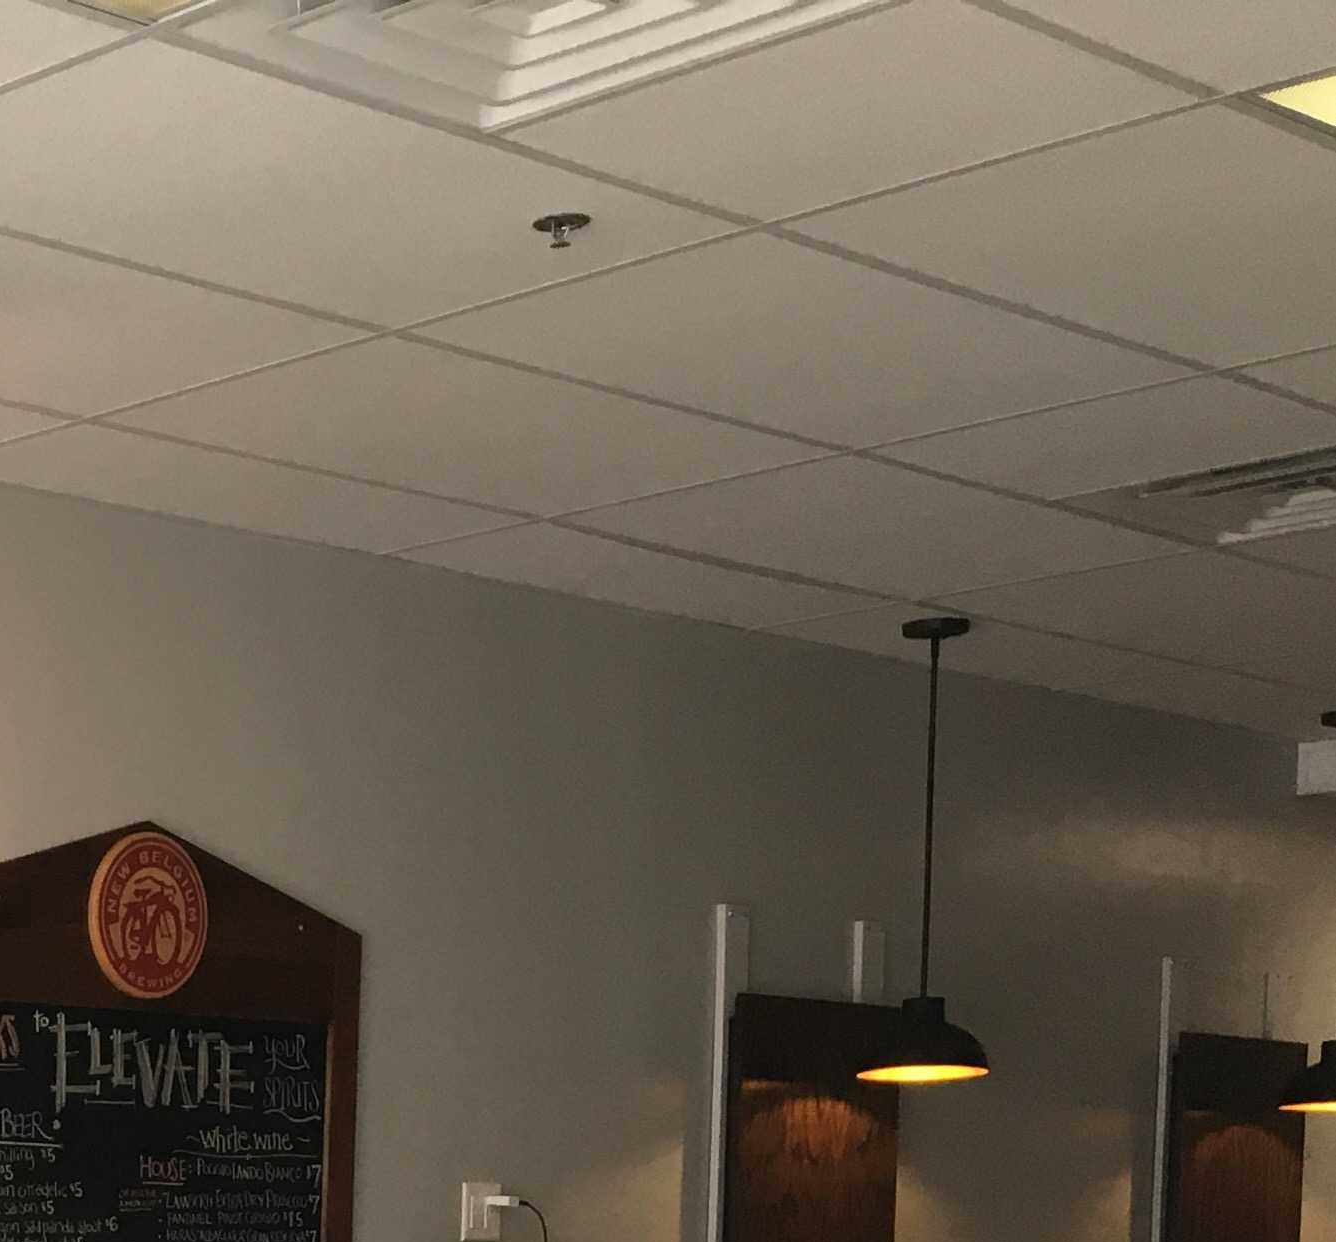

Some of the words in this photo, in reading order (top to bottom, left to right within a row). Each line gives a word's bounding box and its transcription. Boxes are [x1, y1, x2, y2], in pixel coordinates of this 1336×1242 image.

[107, 866, 131, 913] NEW
[138, 851, 198, 923] BELGIUM
[119, 963, 184, 988] BREWING
[33, 1010, 50, 1033] to
[49, 1010, 254, 1114] ELEVATE
[1, 1107, 53, 1140] BEER
[254, 1131, 294, 1151] wine
